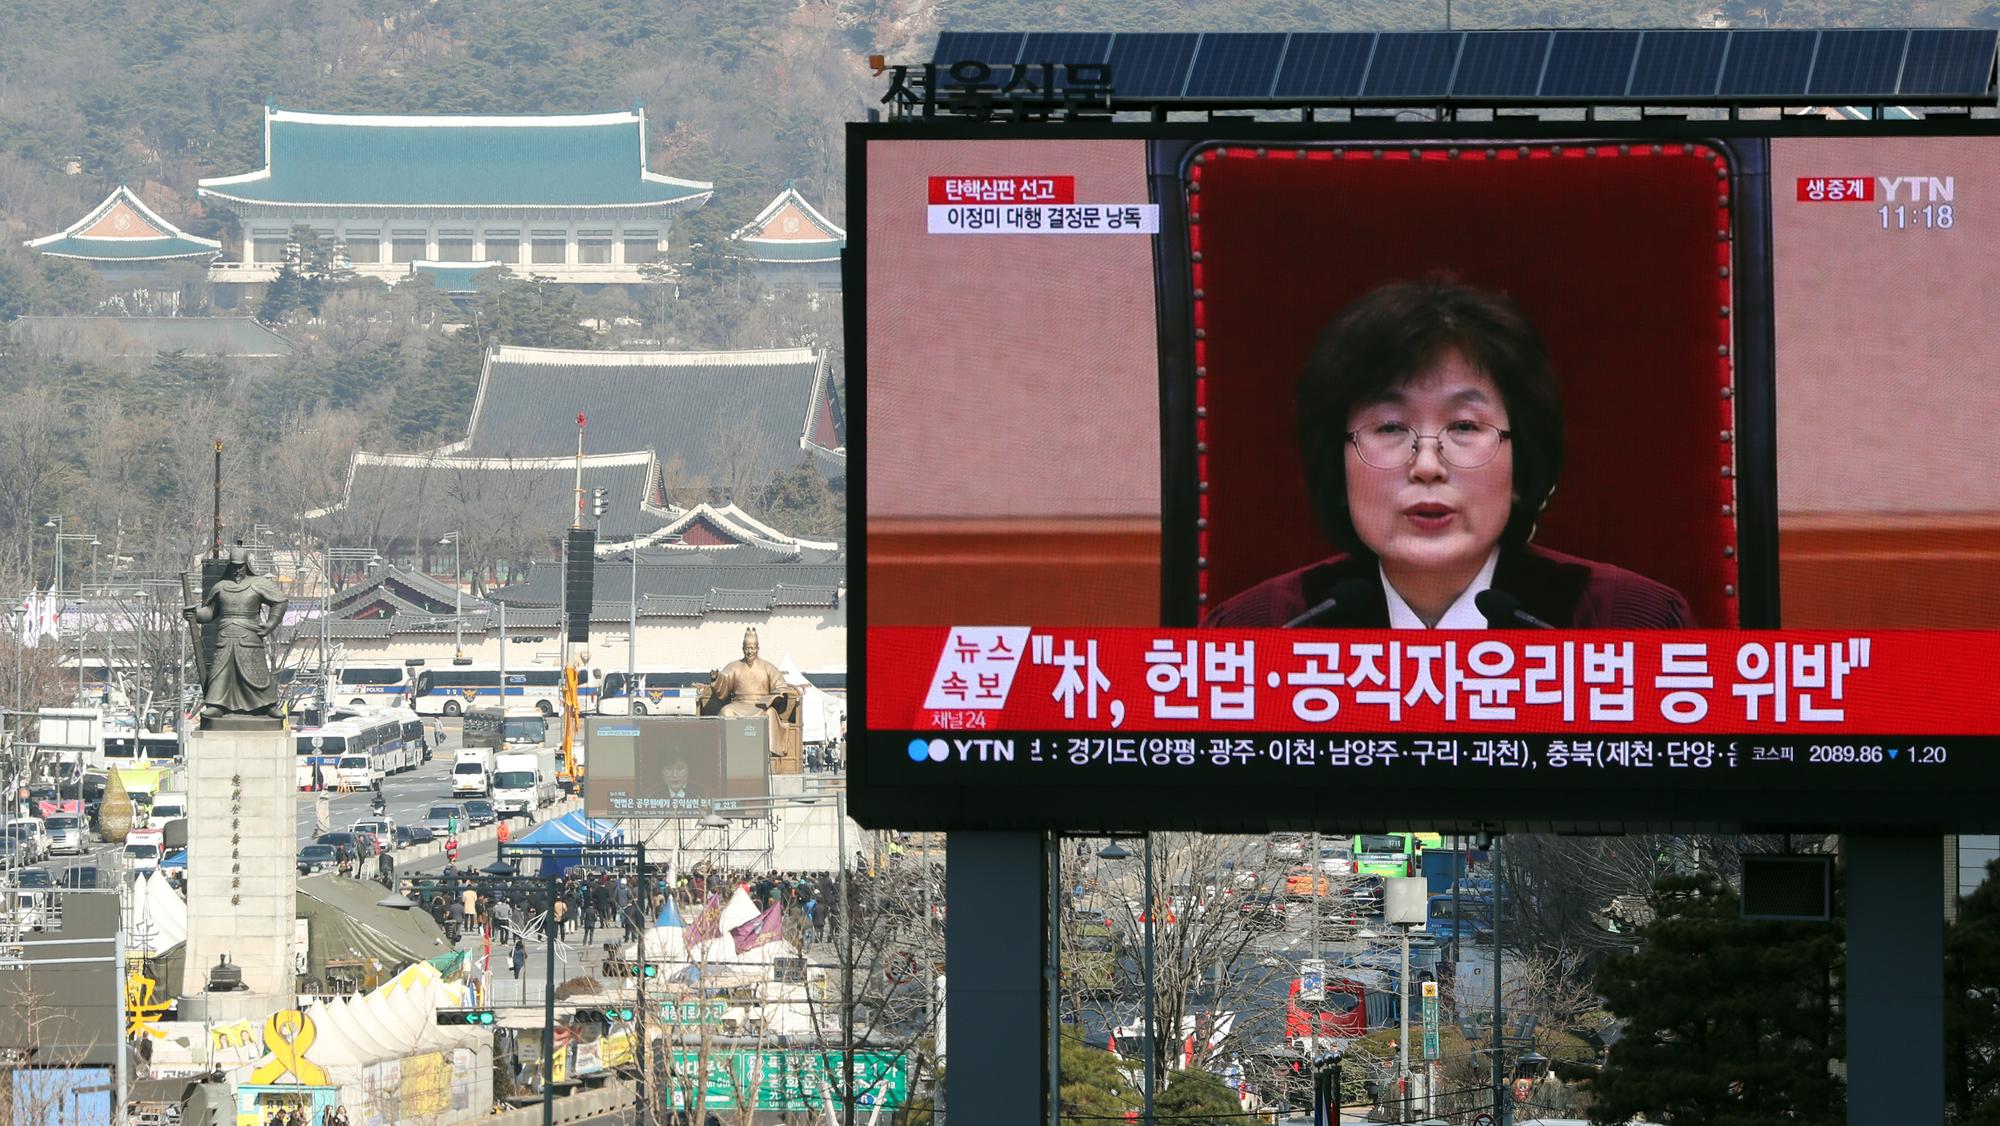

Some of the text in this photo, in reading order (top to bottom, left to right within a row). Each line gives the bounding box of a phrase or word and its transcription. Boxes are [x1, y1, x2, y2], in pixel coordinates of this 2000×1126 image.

[945, 179, 1056, 201] 탄핵심판 선고
[1805, 178, 1864, 200] 생중계
[1878, 176, 1954, 202] YTN
[948, 207, 1143, 229] 이정미 대행 결정문 낭독
[1878, 204, 1954, 229] 11:18
[953, 634, 1015, 664] 뉴스
[940, 671, 1004, 702] 속보
[1032, 635, 1872, 729] "朴, 헌법·공직자윤리법 등 위반"
[953, 738, 1015, 763] YTN
[1752, 745, 1794, 762] 코스피
[1809, 745, 1883, 763] 2089.86
[1907, 745, 1947, 764] 1.20
